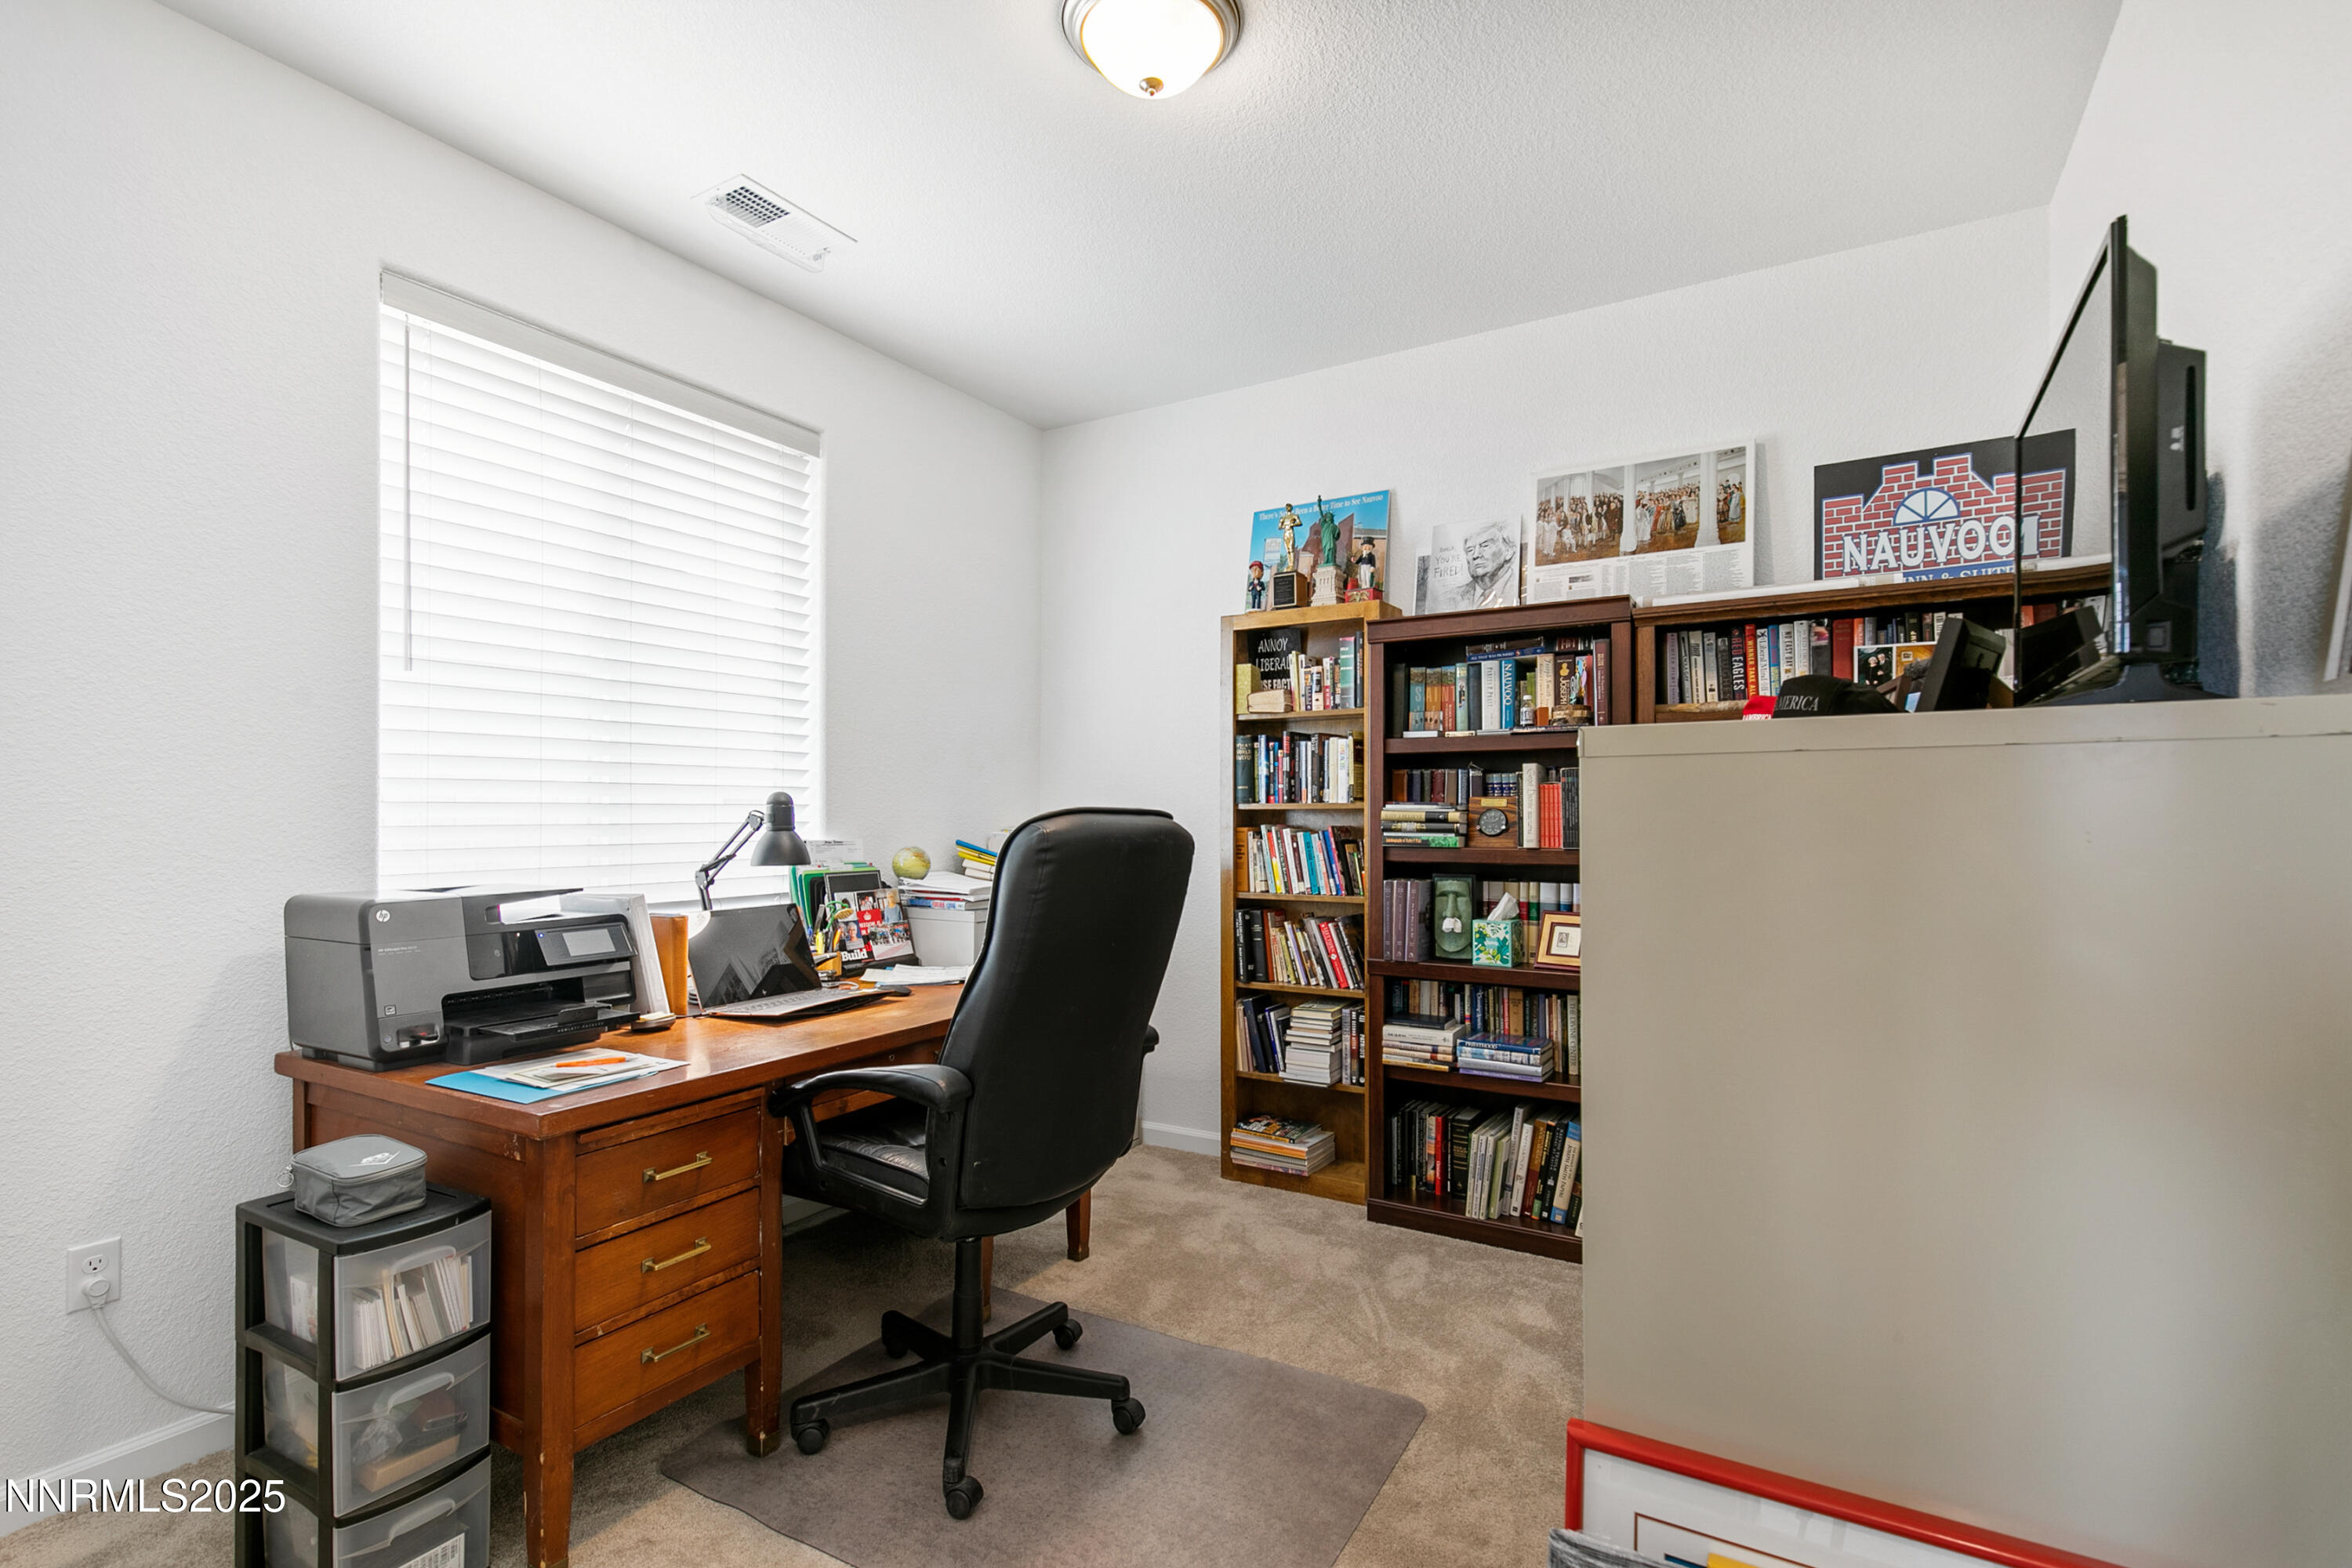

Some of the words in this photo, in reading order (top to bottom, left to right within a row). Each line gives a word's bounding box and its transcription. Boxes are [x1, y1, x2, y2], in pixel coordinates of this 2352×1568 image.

[1259, 512, 1278, 521] There's
[1295, 506, 1308, 514] Been
[1330, 501, 1343, 510] Time
[1363, 495, 1384, 504] Nauvoo
[1842, 515, 2016, 573] NAUVOO
[1434, 564, 1463, 579] FIRED!
[1258, 637, 1288, 653] ANNOY
[1731, 637, 1743, 655] RED
[1759, 640, 1768, 662] Liberal
[1255, 656, 1291, 672] LIBERAL
[1732, 655, 1745, 691] EAGLES
[1261, 679, 1272, 691] SE
[1272, 677, 1291, 690] FACT
[1559, 677, 1570, 705] JOSEPH
[1775, 695, 1820, 712] MERICA
[377, 909, 390, 923] hp
[841, 948, 869, 962] Build
